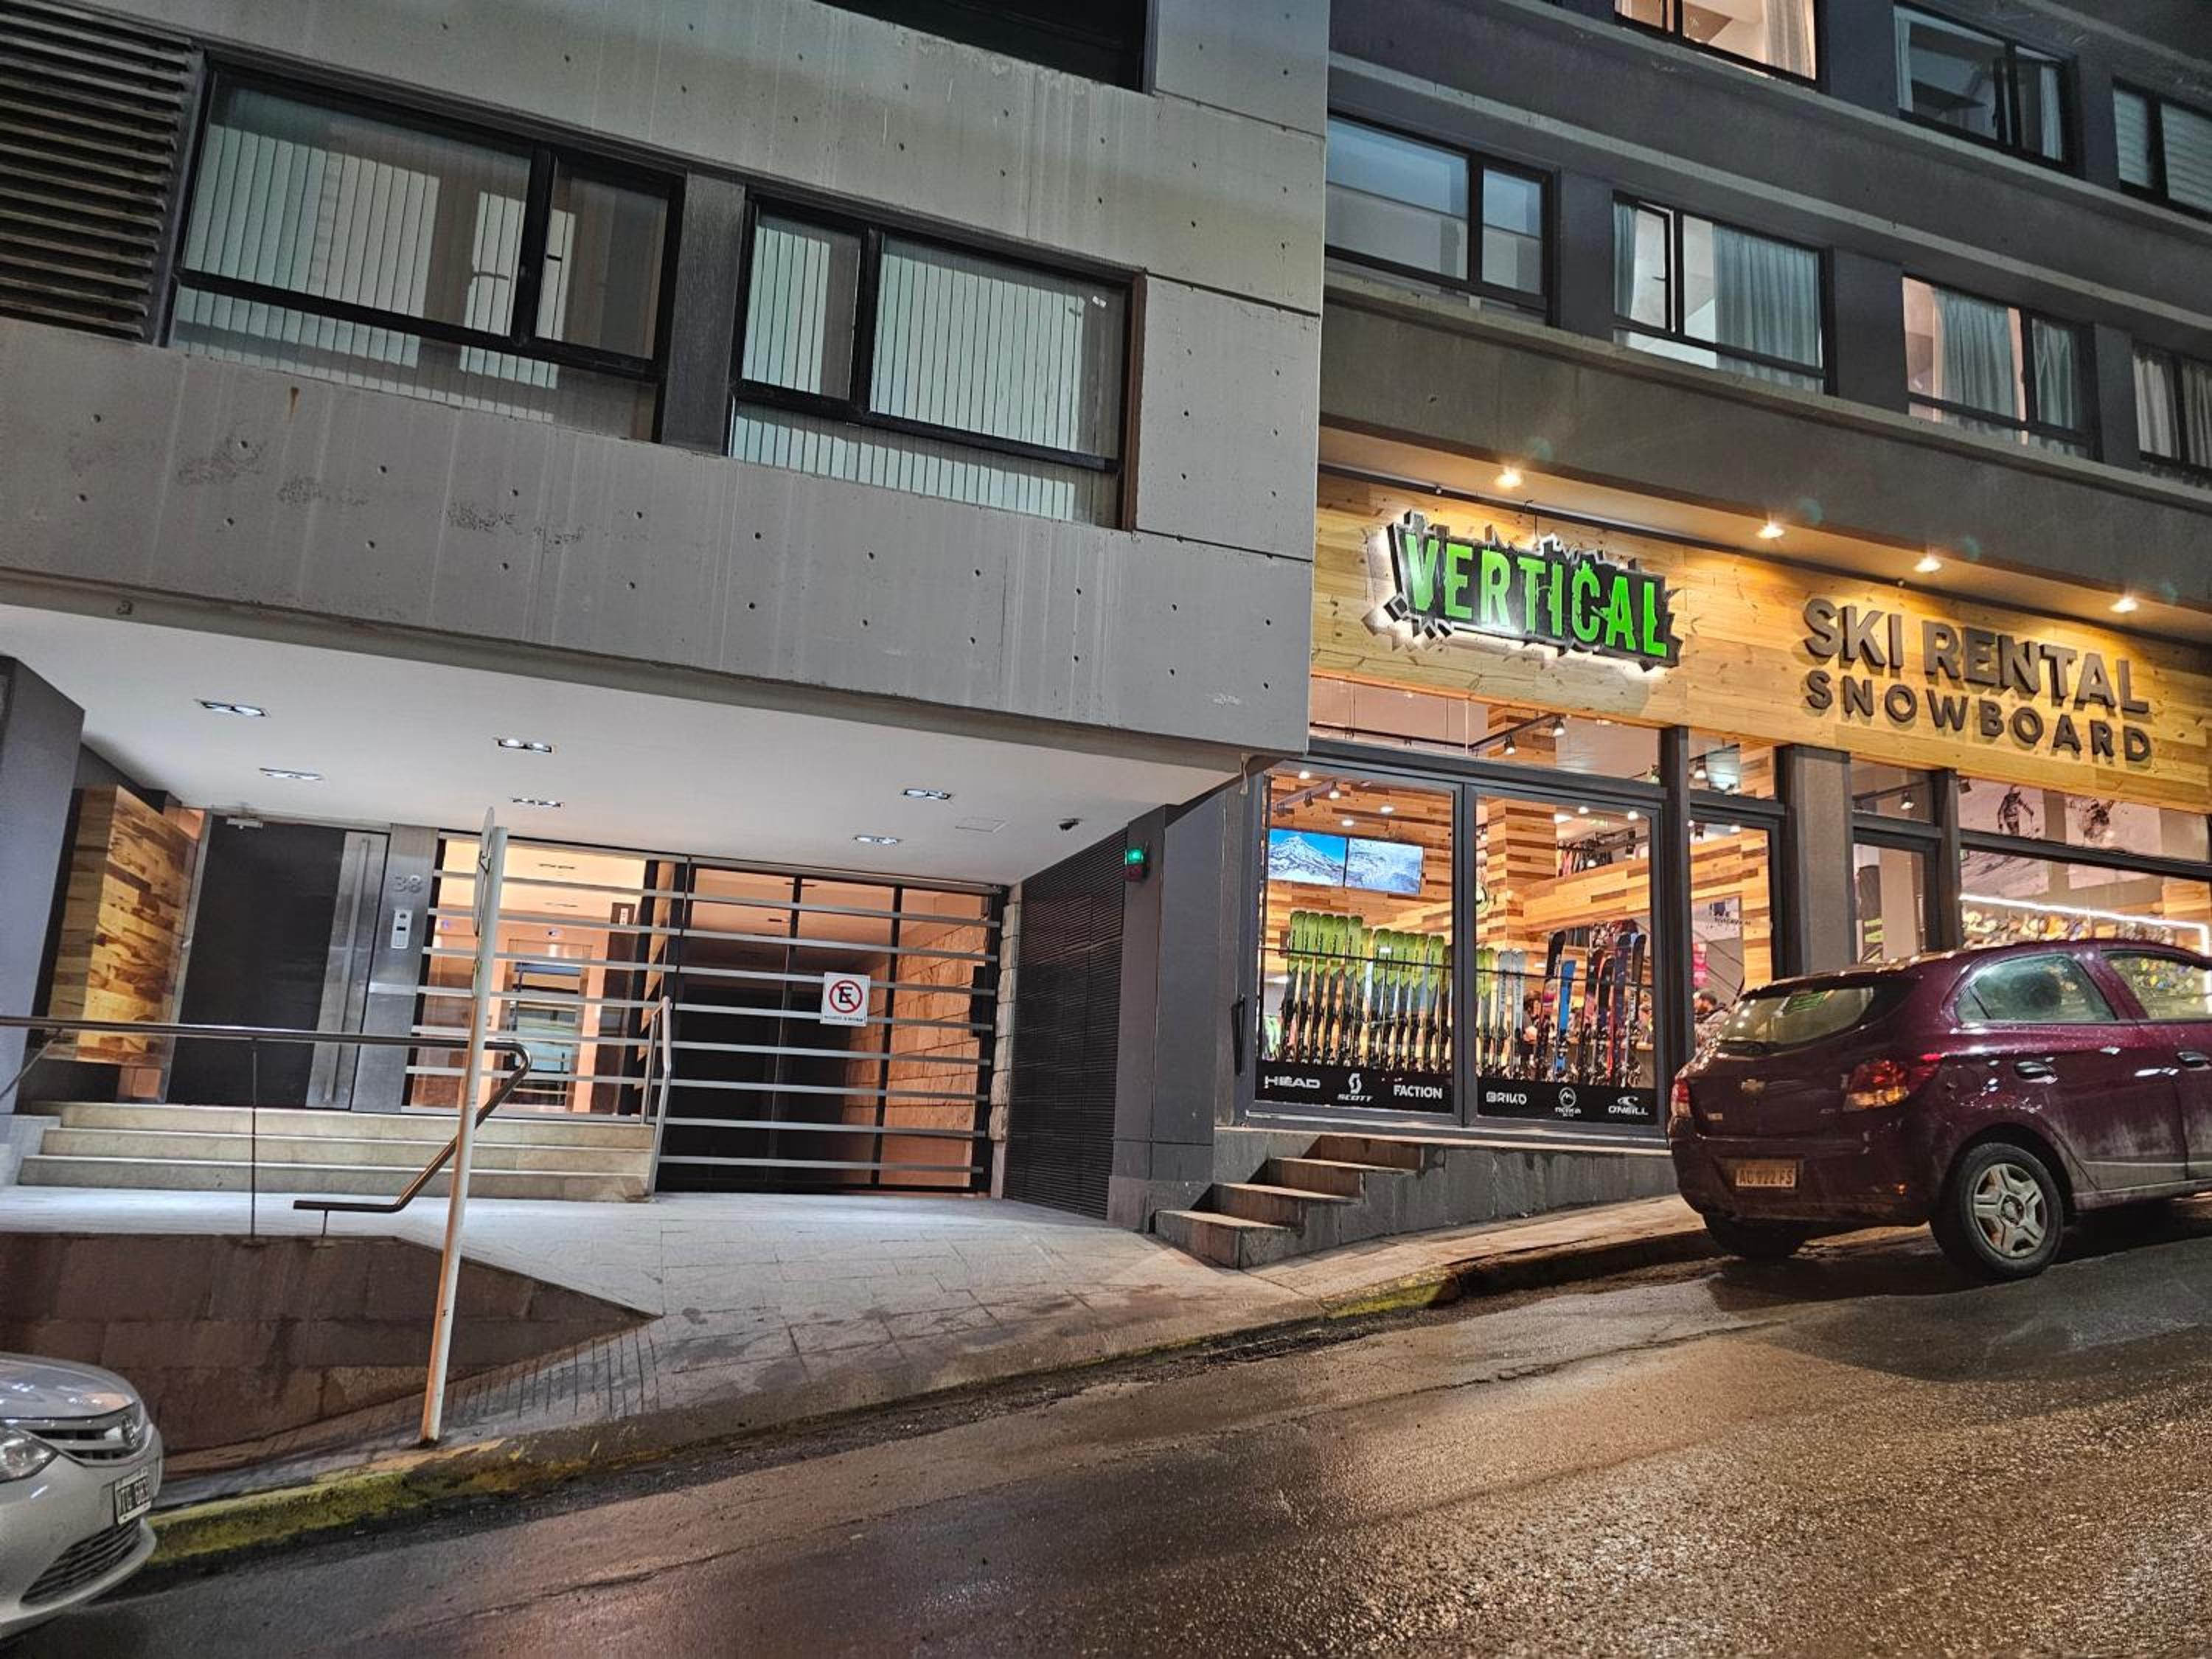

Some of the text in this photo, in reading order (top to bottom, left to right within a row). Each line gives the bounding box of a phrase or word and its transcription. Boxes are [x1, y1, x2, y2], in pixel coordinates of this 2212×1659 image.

[1403, 532, 1667, 658] VERTICAL
[1803, 598, 2150, 714] SKI RENTAL
[1806, 670, 2152, 762] SNOWBOARD
[392, 874, 422, 893] 38
[839, 987, 852, 1003] E
[1265, 1076, 1321, 1089] HEAD
[1338, 1094, 1373, 1102] SCOTT
[1393, 1085, 1443, 1099] FACTION
